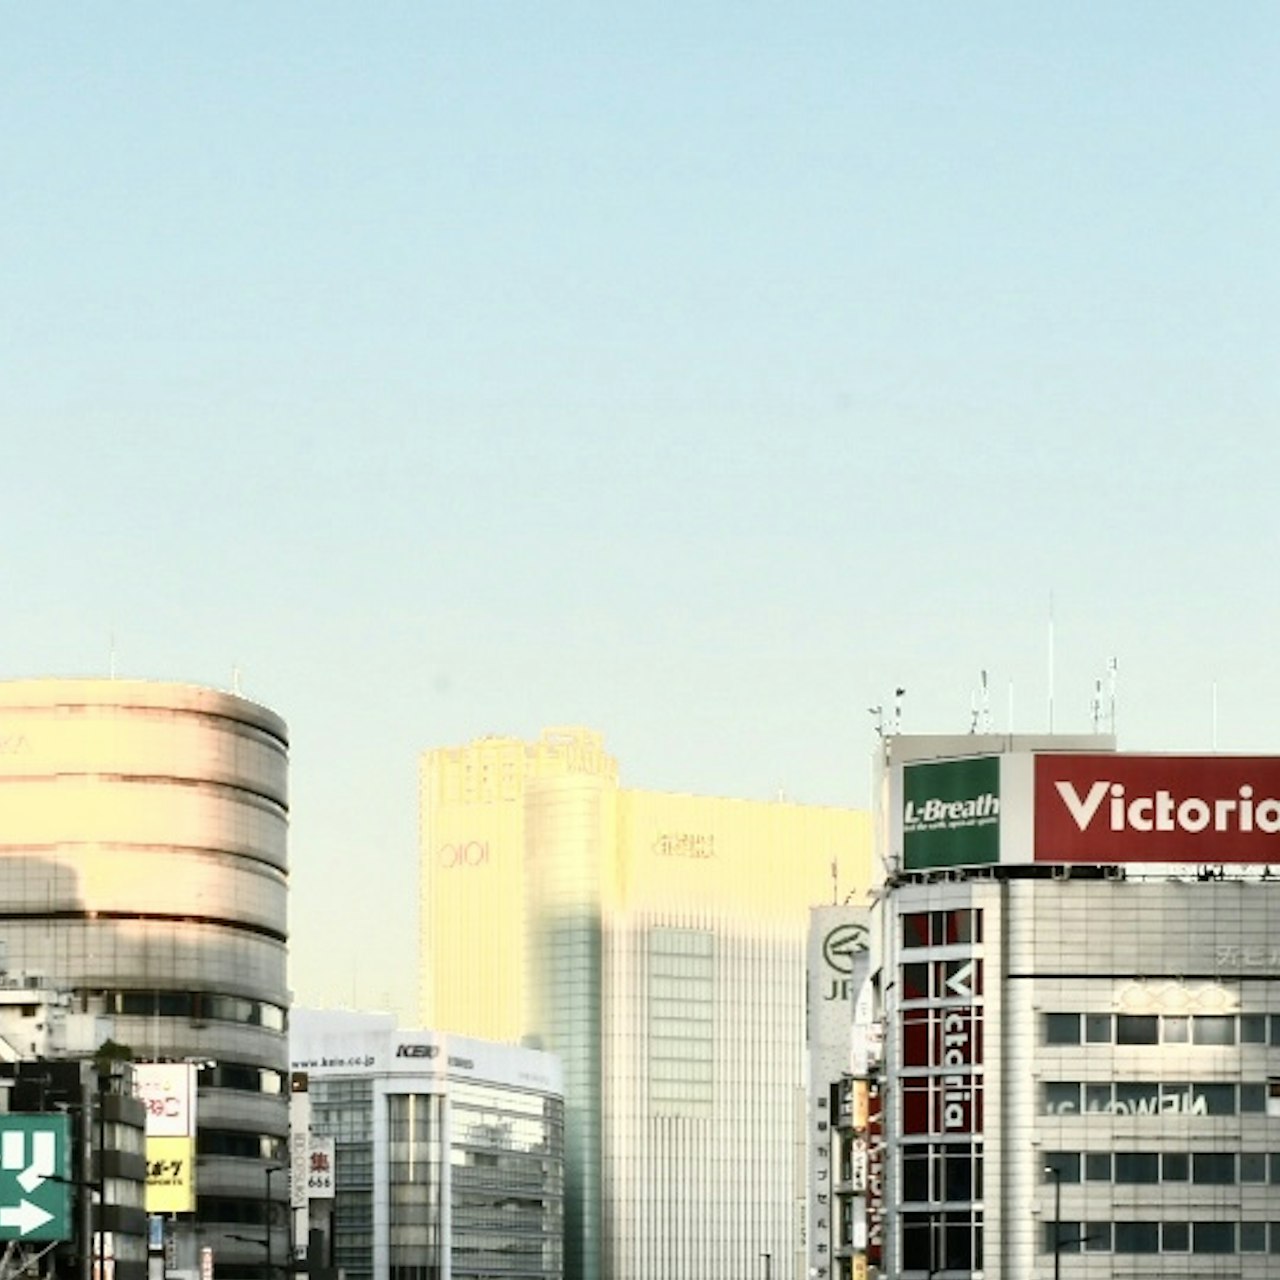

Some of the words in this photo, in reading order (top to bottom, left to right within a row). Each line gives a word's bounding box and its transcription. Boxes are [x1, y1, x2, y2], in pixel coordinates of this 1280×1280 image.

[905, 792, 999, 823] L-Breath
[396, 1044, 441, 1059] KEIO
[945, 958, 972, 1129] Victoria
[292, 1055, 375, 1068] www.keio.co.jp
